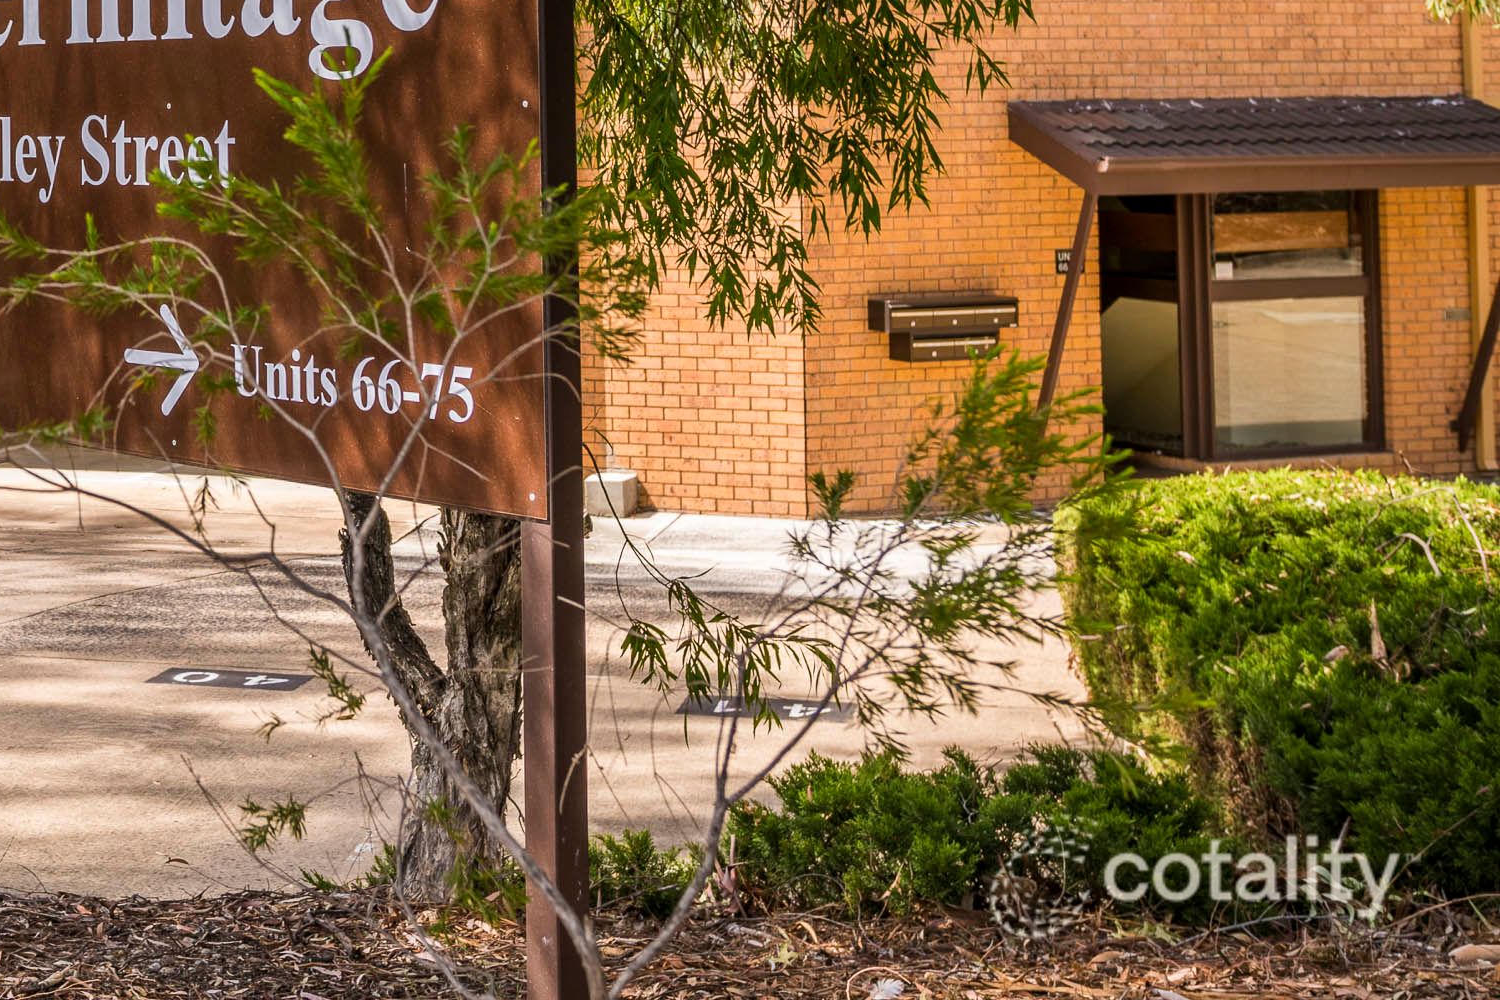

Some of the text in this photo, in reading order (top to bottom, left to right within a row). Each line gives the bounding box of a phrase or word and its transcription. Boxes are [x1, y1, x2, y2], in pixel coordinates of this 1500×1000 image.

[81, 114, 236, 189] Street
[230, 343, 475, 423] Units 66-75
[172, 671, 290, 686] 40
